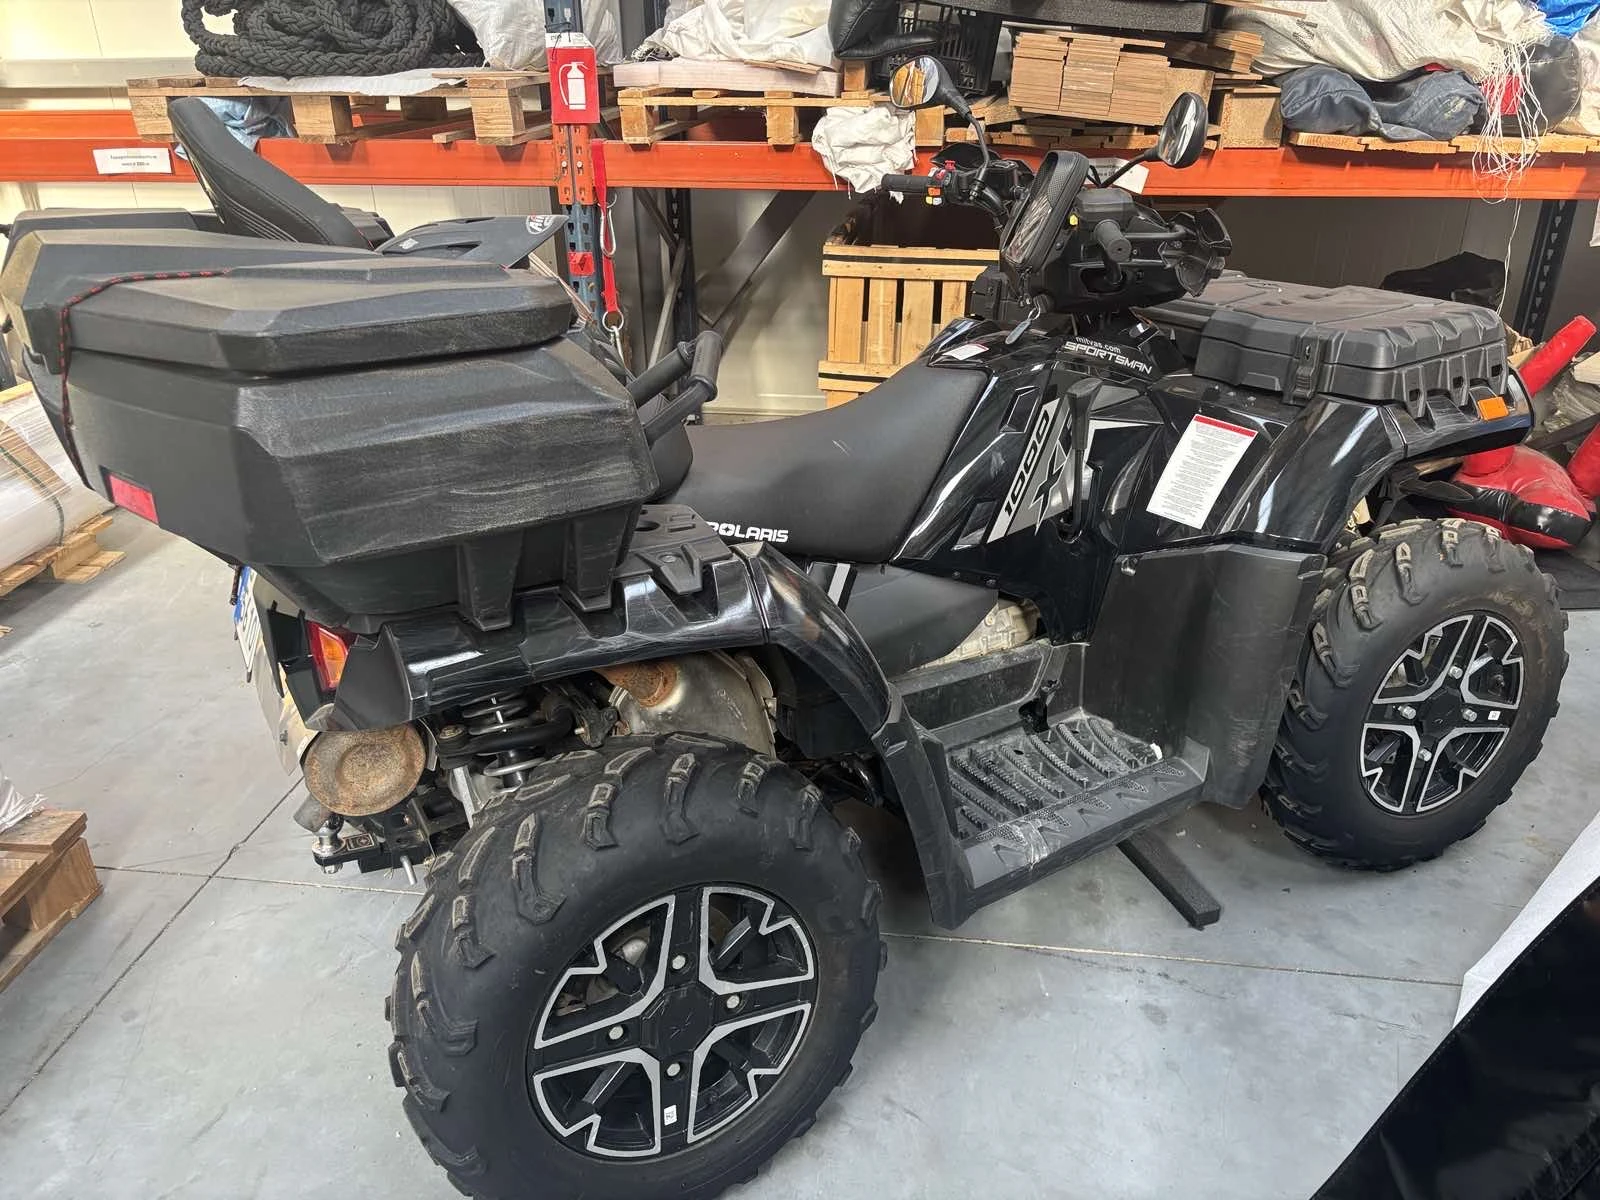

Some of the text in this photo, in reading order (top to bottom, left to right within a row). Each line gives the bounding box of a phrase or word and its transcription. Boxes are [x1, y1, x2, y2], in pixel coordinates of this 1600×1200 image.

[1064, 341, 1153, 375] SPORTSMAN
[1004, 409, 1050, 516] 1000
[705, 520, 789, 543] POLARIS
